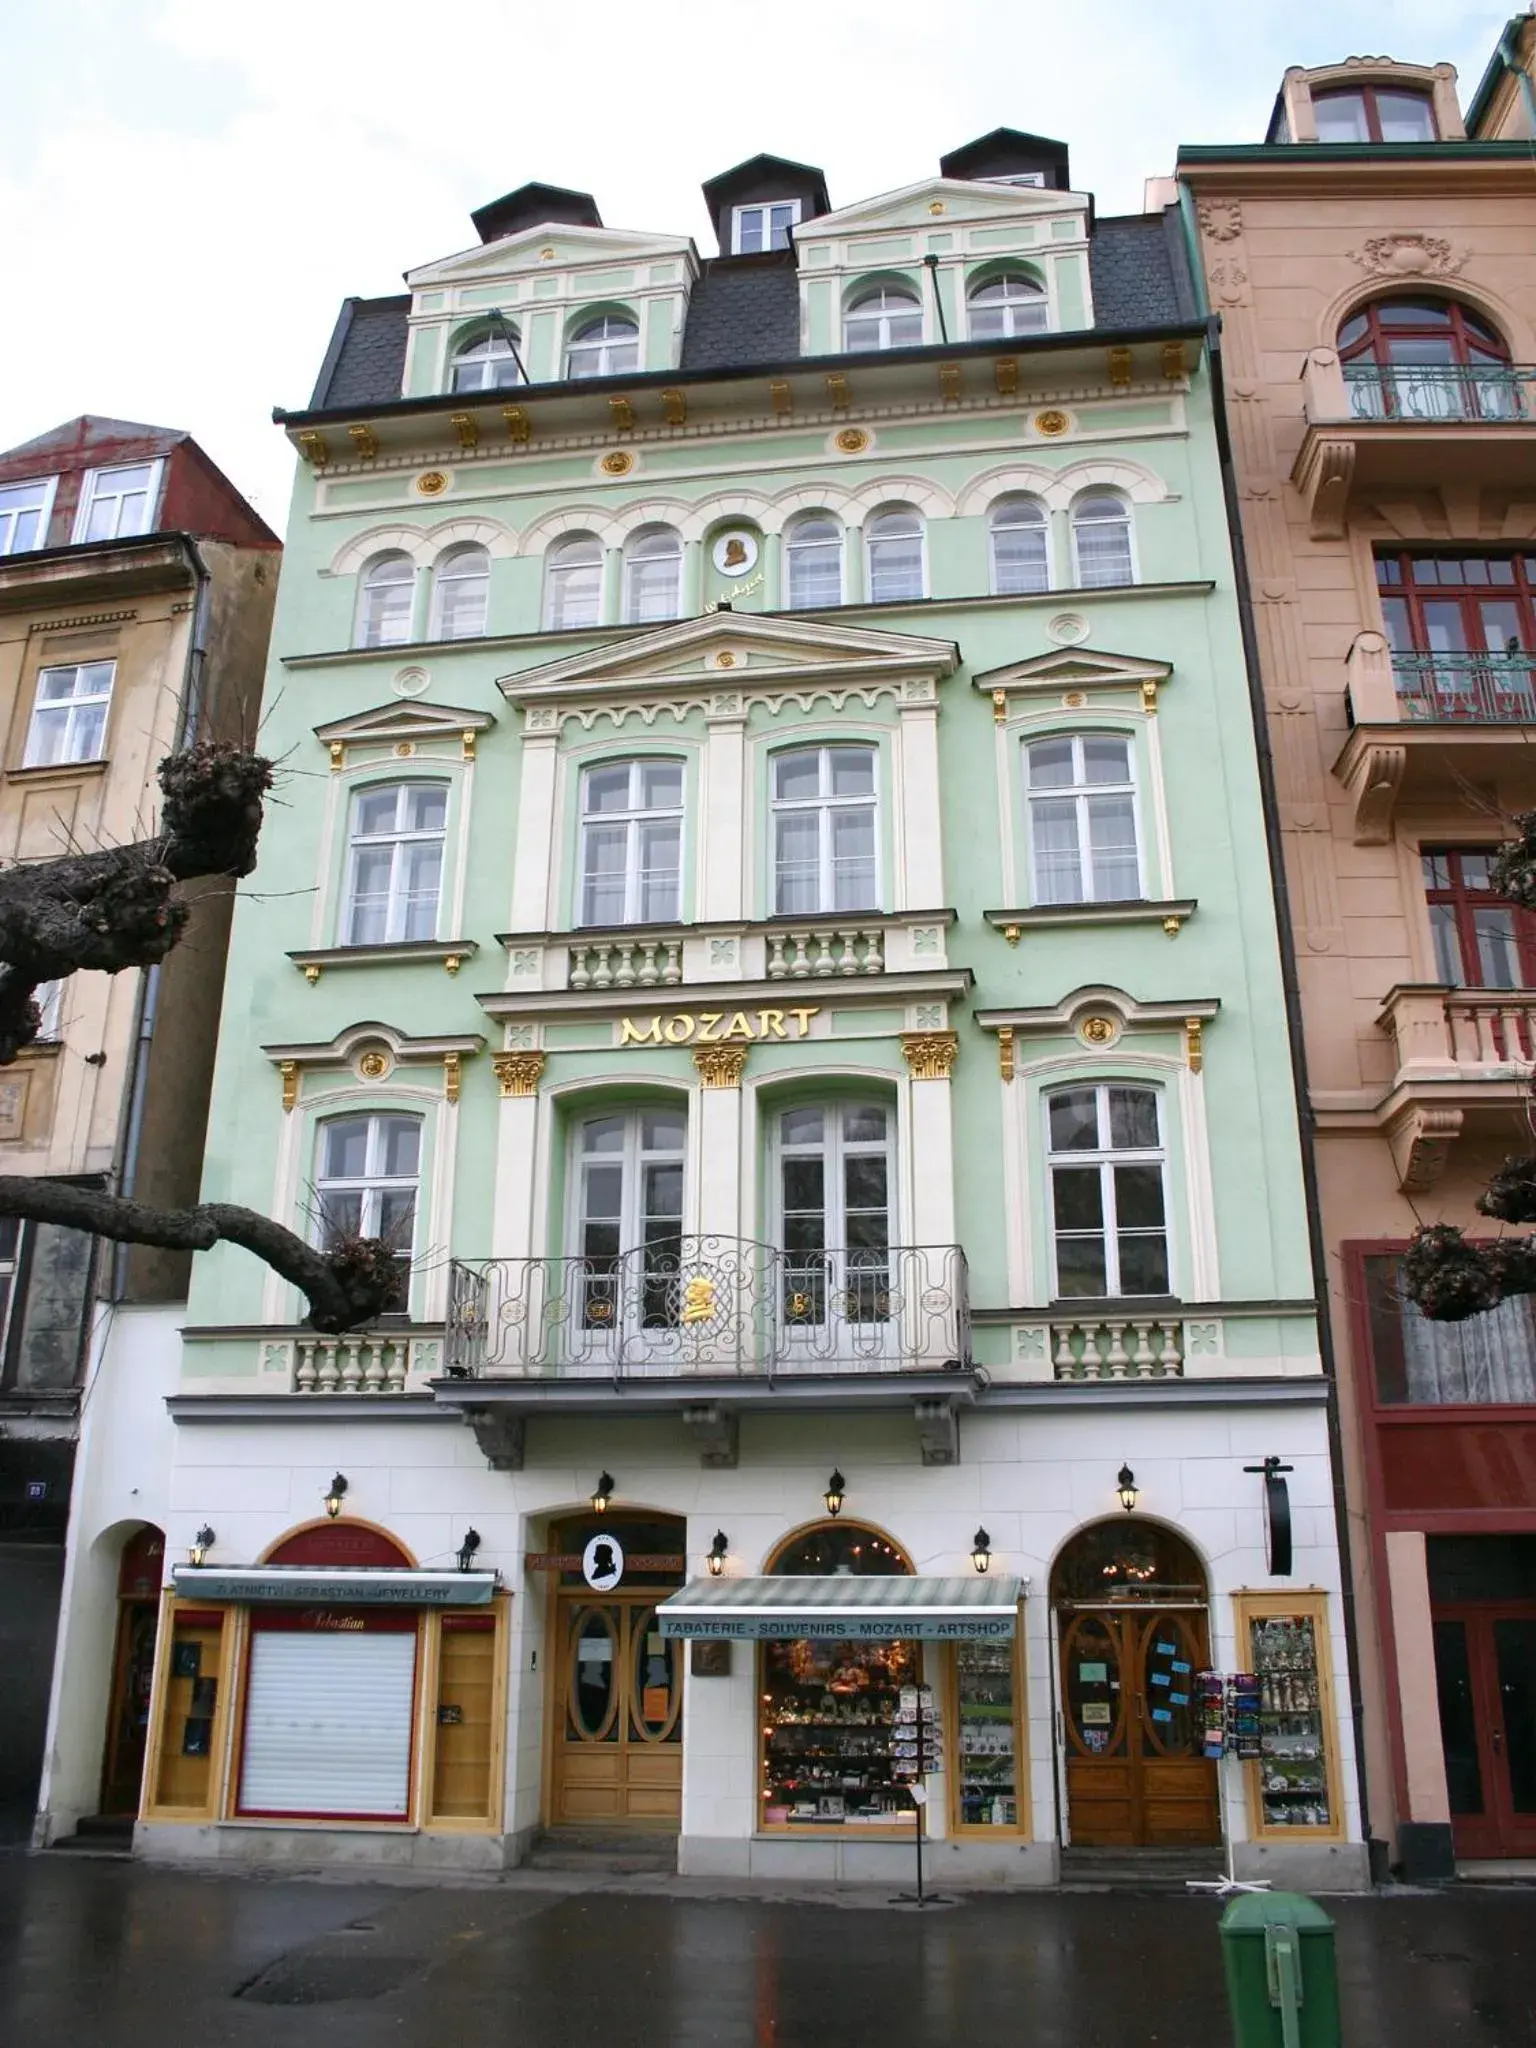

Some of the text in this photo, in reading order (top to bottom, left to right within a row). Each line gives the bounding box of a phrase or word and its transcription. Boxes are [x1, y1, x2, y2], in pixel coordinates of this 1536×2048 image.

[620, 1007, 821, 1046] MOZART
[294, 1584, 363, 1597] SEBASTIAN
[375, 1587, 450, 1599] JEWELLERY
[300, 1609, 365, 1630] Sebastian
[666, 1622, 746, 1635] TABATERIE
[758, 1622, 846, 1635] SOUVENIRS
[859, 1622, 924, 1635] MOZART
[936, 1622, 1010, 1635] ARTSHOP
